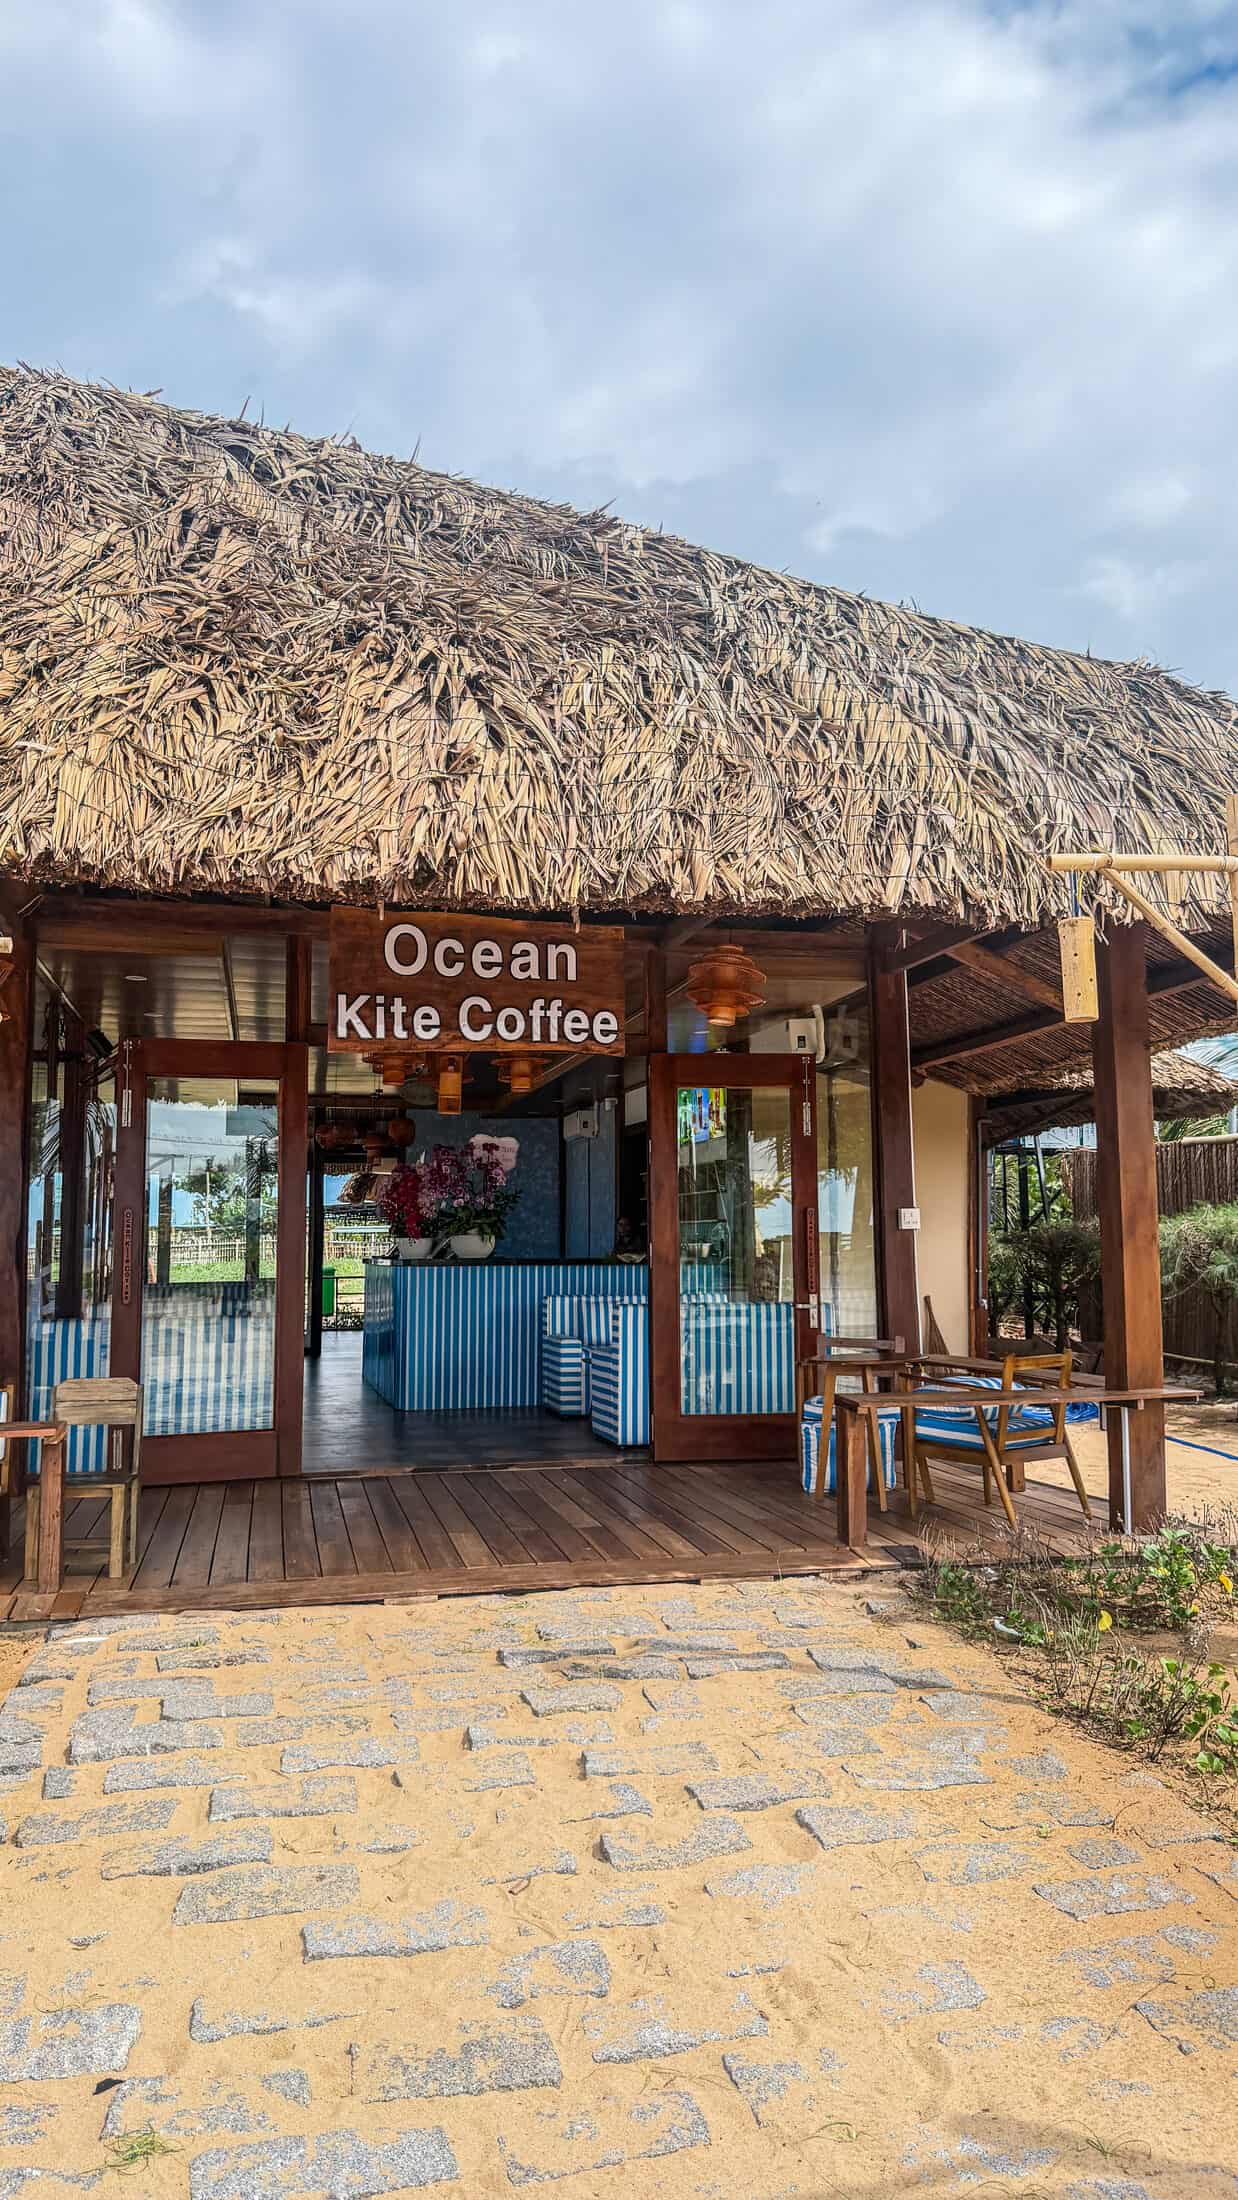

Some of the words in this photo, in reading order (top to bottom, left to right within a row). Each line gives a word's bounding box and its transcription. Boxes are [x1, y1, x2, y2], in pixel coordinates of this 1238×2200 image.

[384, 923, 577, 981] Ocean
[337, 994, 441, 1040] Kite
[459, 996, 618, 1044] Coffee
